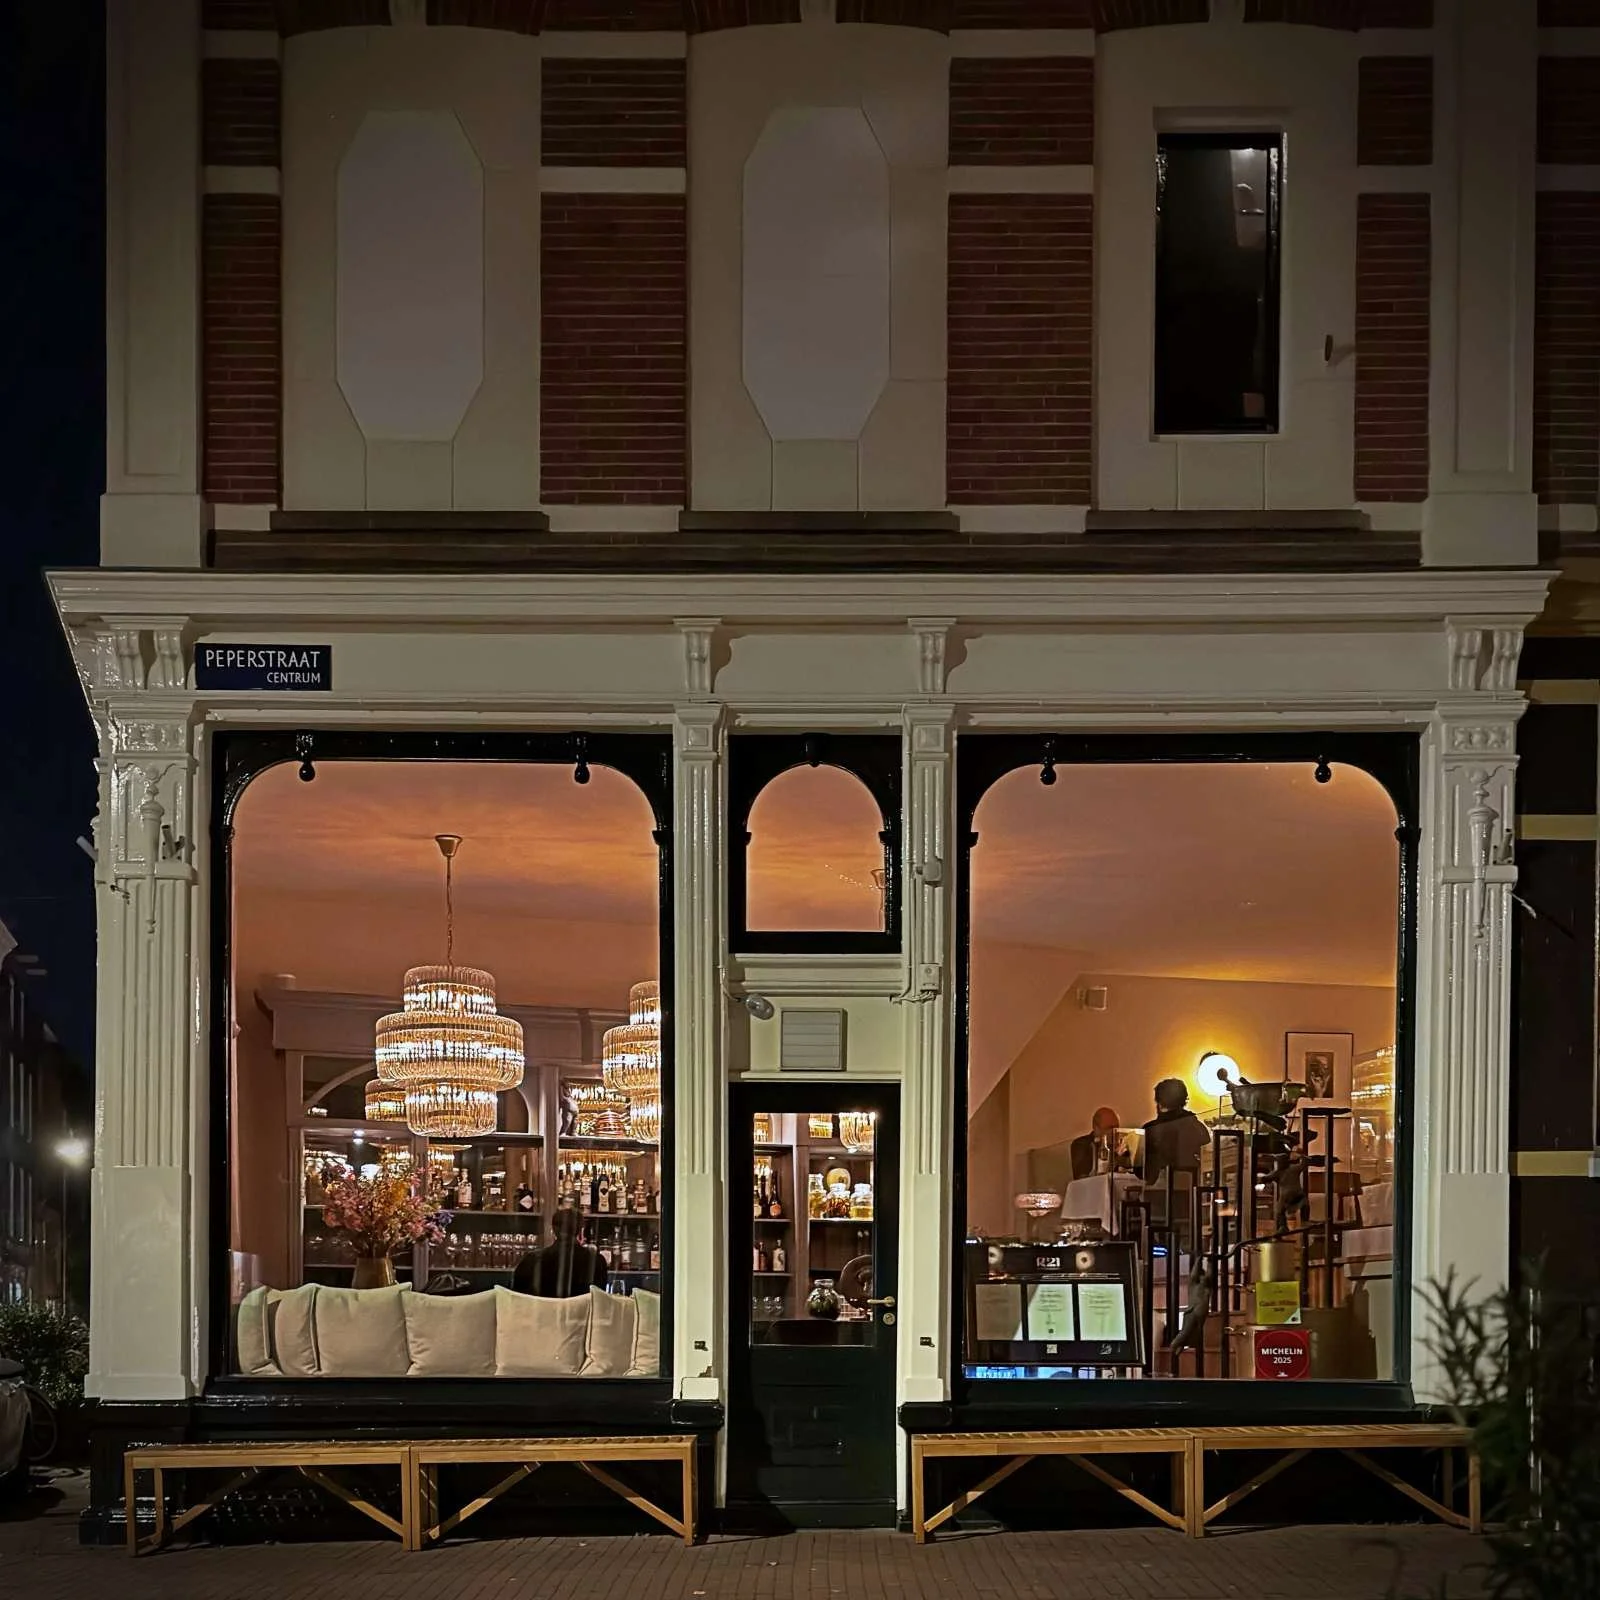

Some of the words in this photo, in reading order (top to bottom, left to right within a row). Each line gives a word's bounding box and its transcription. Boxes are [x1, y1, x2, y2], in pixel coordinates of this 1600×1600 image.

[205, 649, 321, 668] PEPERSTRAAT
[266, 671, 321, 684] CENTRUM
[1261, 1347, 1303, 1356] MICHELIN
[1273, 1356, 1292, 1364] 2025
